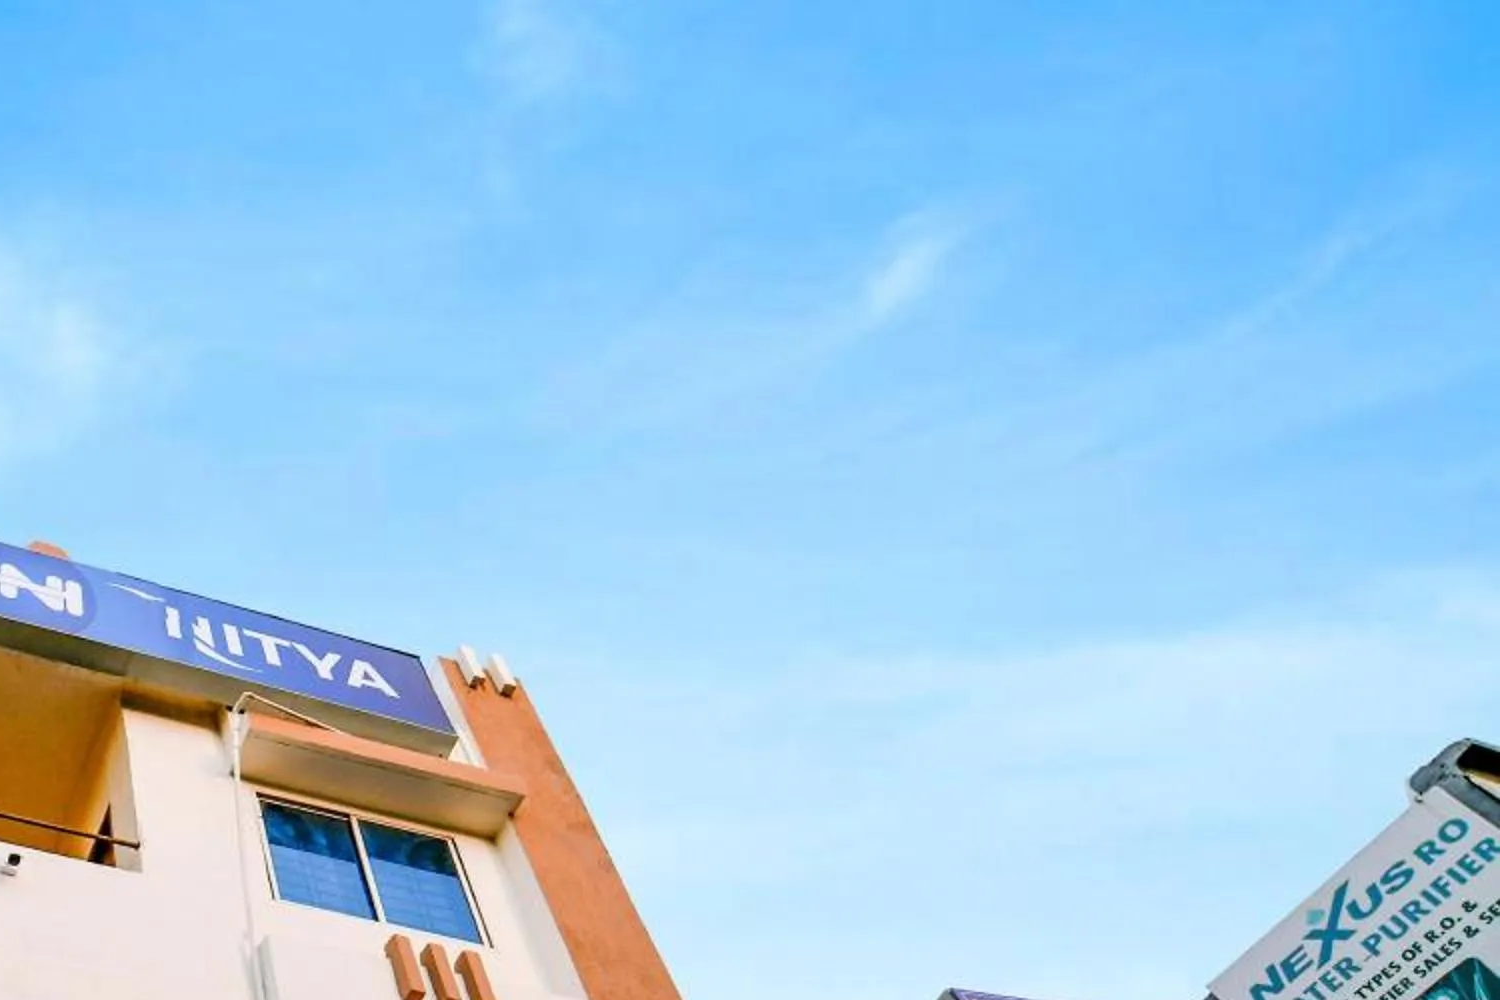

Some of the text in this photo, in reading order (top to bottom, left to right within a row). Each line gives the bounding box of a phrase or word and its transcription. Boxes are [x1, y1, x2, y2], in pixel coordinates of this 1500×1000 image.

[107, 582, 401, 700] NITYA
[1413, 817, 1470, 866] RO
[1354, 961, 1402, 1000] TYPES
[1401, 941, 1423, 962] OF
[1461, 900, 1478, 913] &
[1412, 937, 1463, 978] SALES
[1462, 925, 1480, 939] &
[1478, 898, 1500, 925] SE
